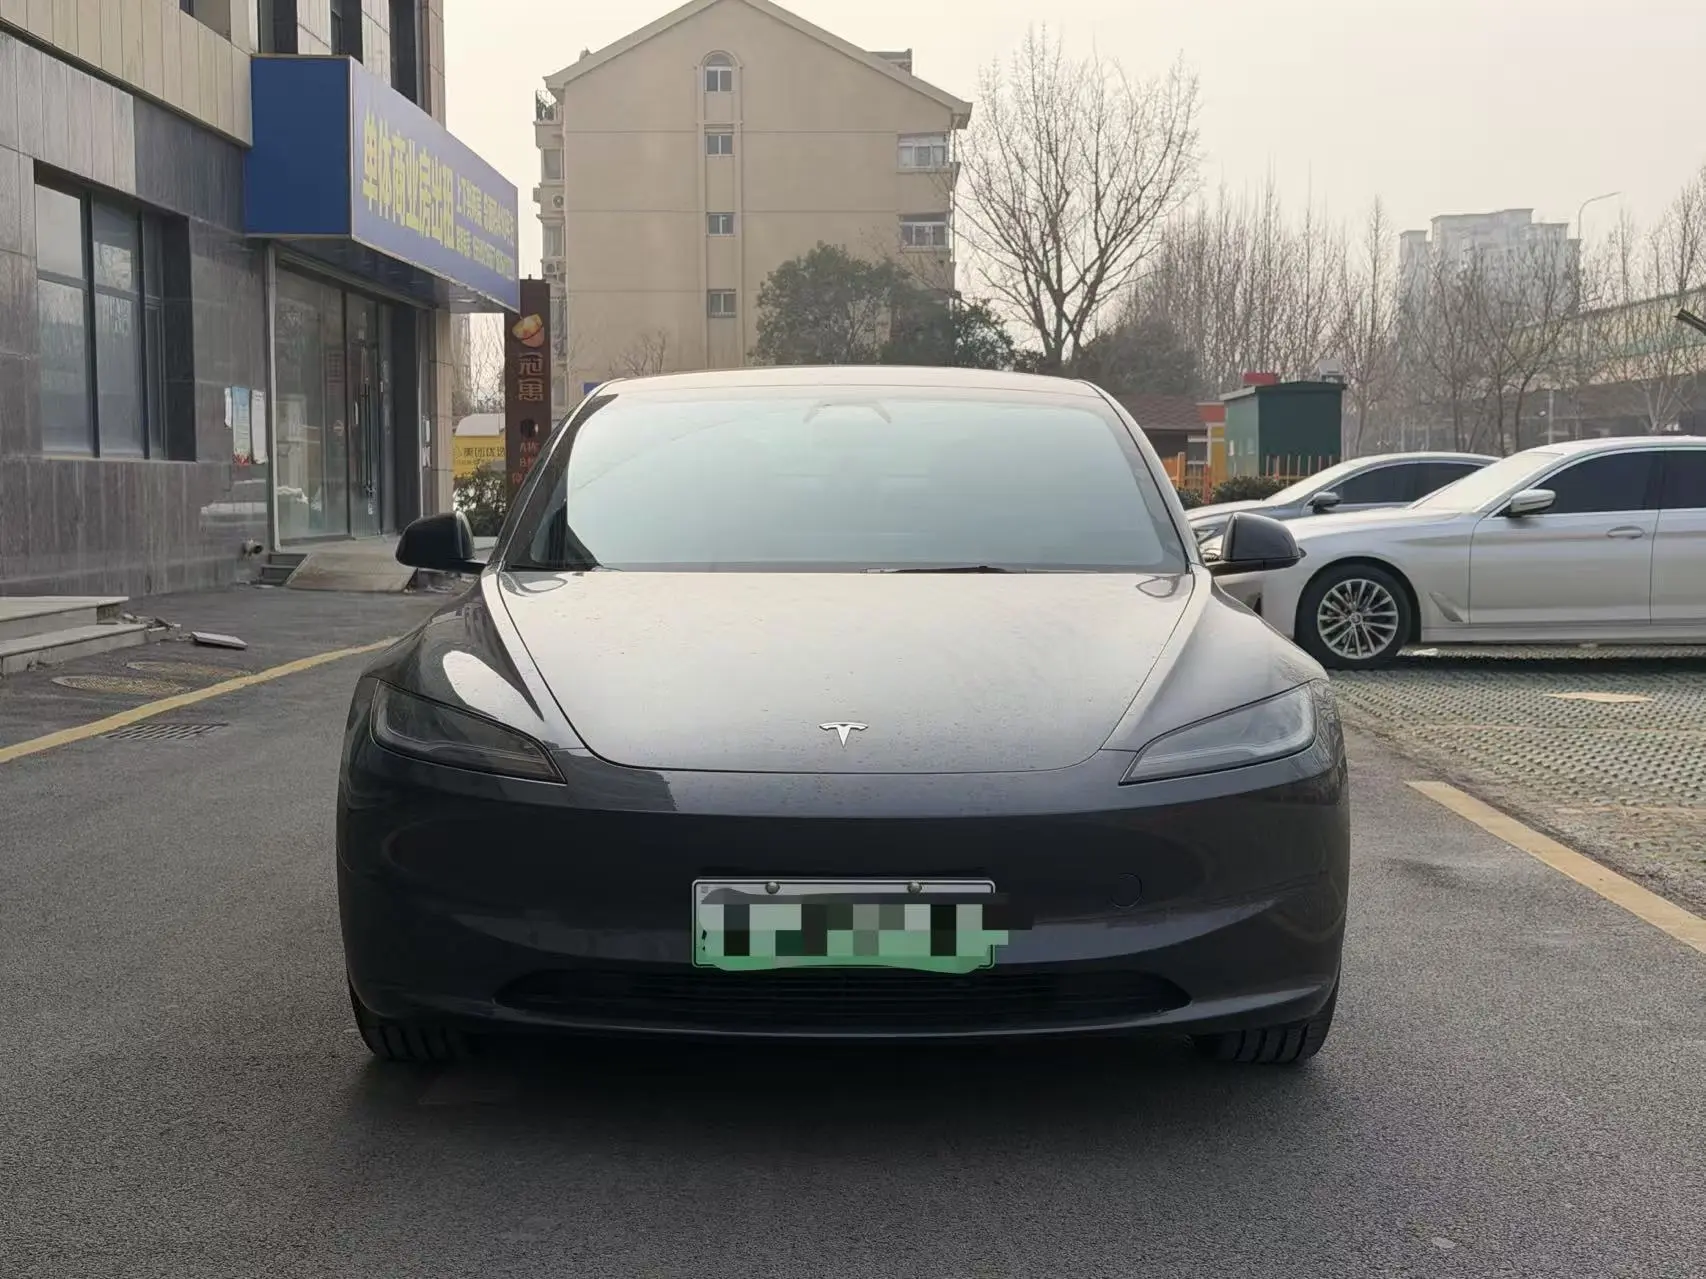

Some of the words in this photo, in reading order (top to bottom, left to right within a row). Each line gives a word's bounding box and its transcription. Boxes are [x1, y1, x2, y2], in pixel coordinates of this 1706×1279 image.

[363, 109, 455, 249] 单体商业房出租
